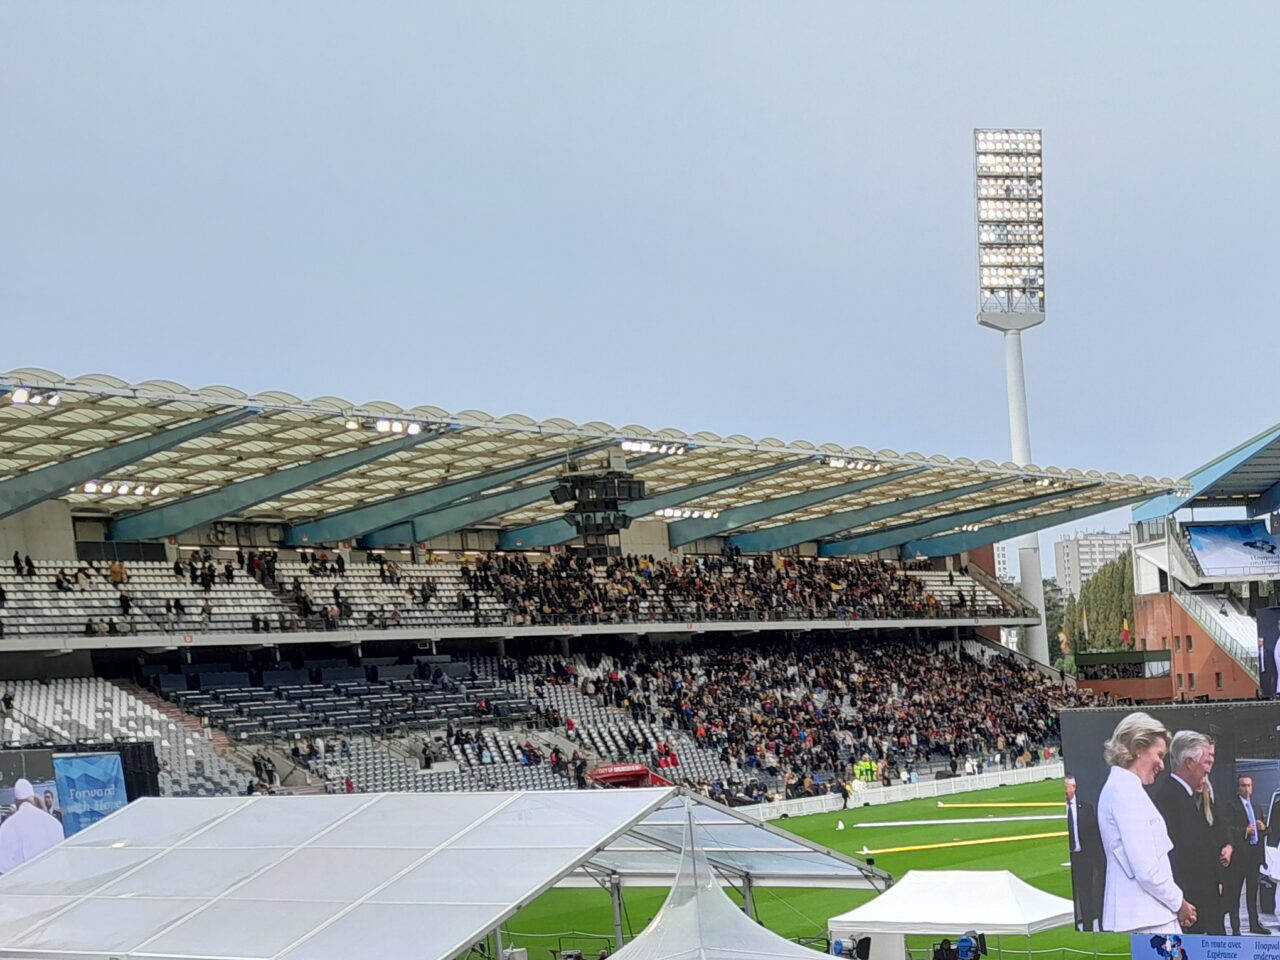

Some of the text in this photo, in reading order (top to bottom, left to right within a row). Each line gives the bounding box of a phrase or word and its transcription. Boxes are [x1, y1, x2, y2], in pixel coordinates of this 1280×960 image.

[69, 783, 115, 800] Forward
[1201, 939, 1242, 949] En route avec
[1255, 941, 1280, 951] Hoopvol
